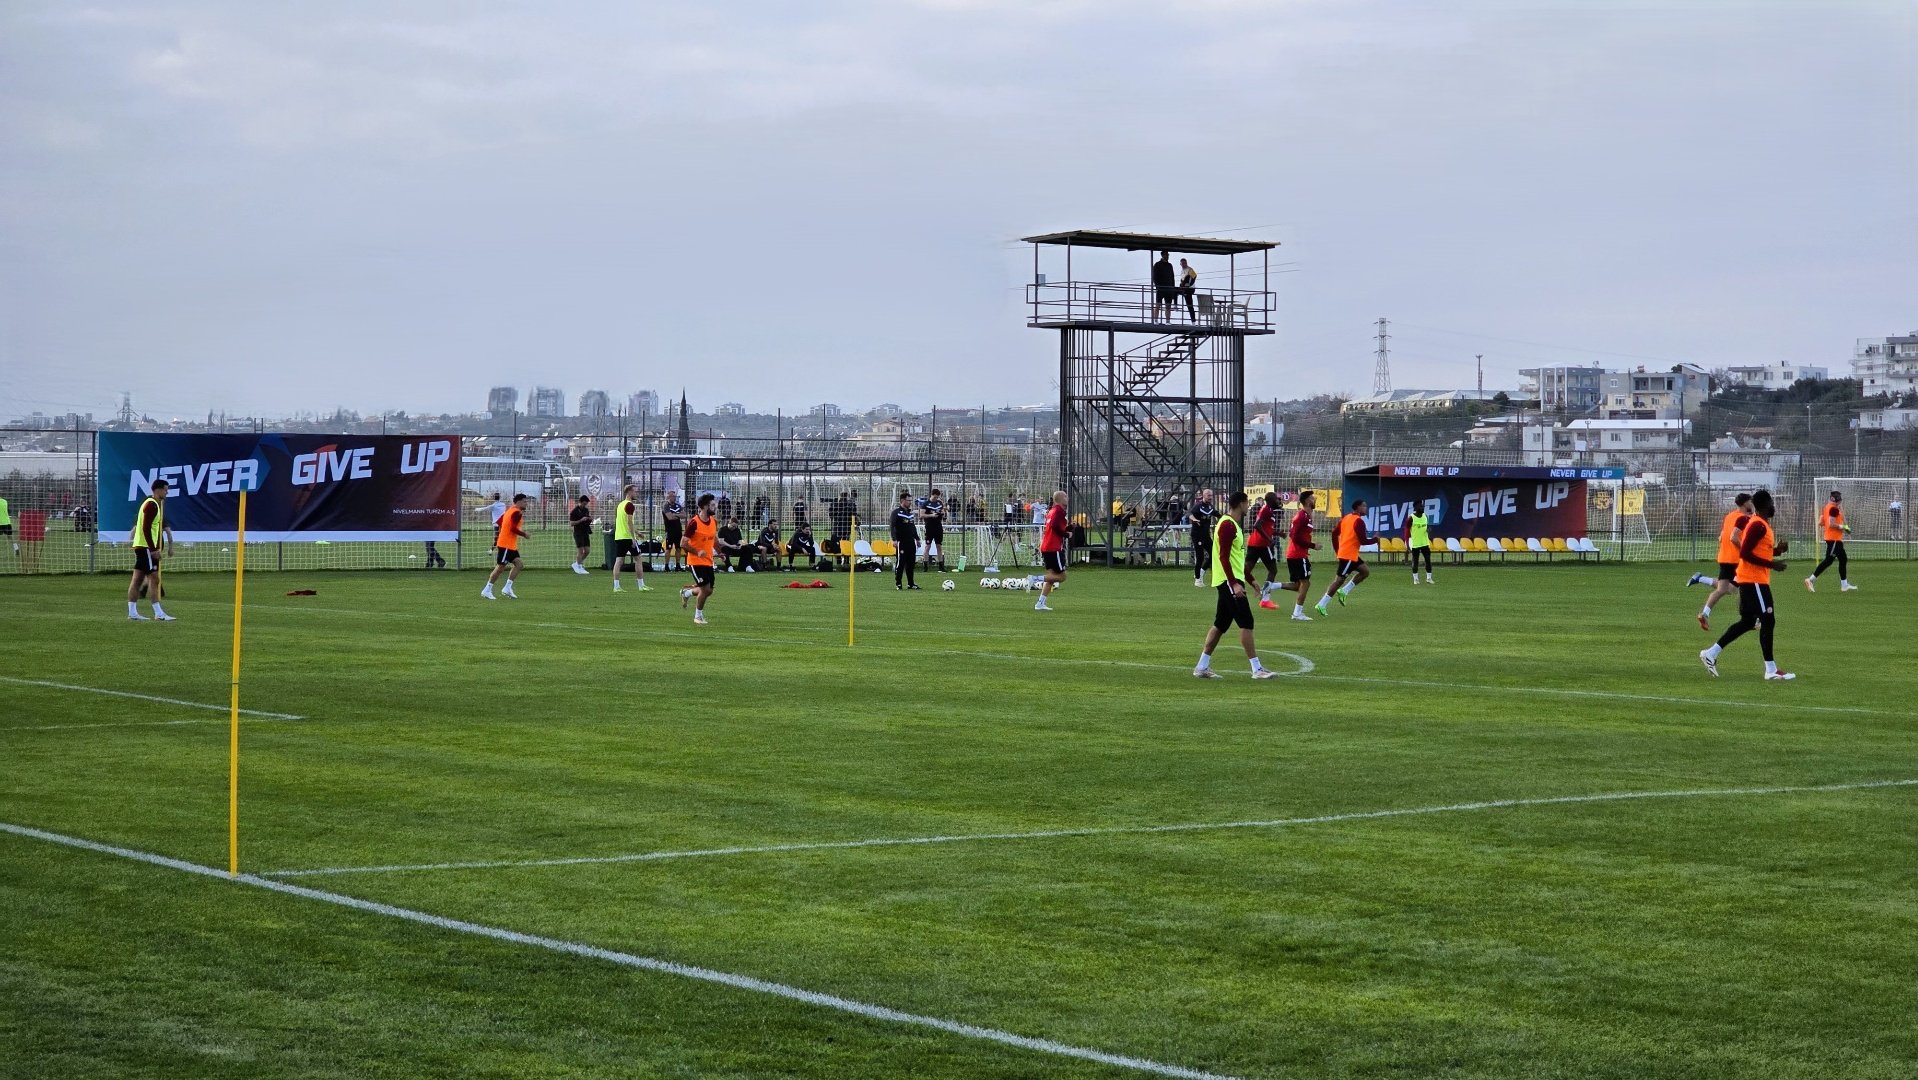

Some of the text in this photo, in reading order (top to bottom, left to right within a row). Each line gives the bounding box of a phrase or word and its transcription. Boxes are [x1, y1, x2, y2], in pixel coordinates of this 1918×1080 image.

[128, 440, 451, 501] NEVER GIVE UP
[1394, 466, 1459, 476] NEVER GIVE UP
[1550, 469, 1613, 478] NEVER GIVE UP
[1461, 487, 1518, 519] GIVE
[1535, 482, 1569, 509] UP
